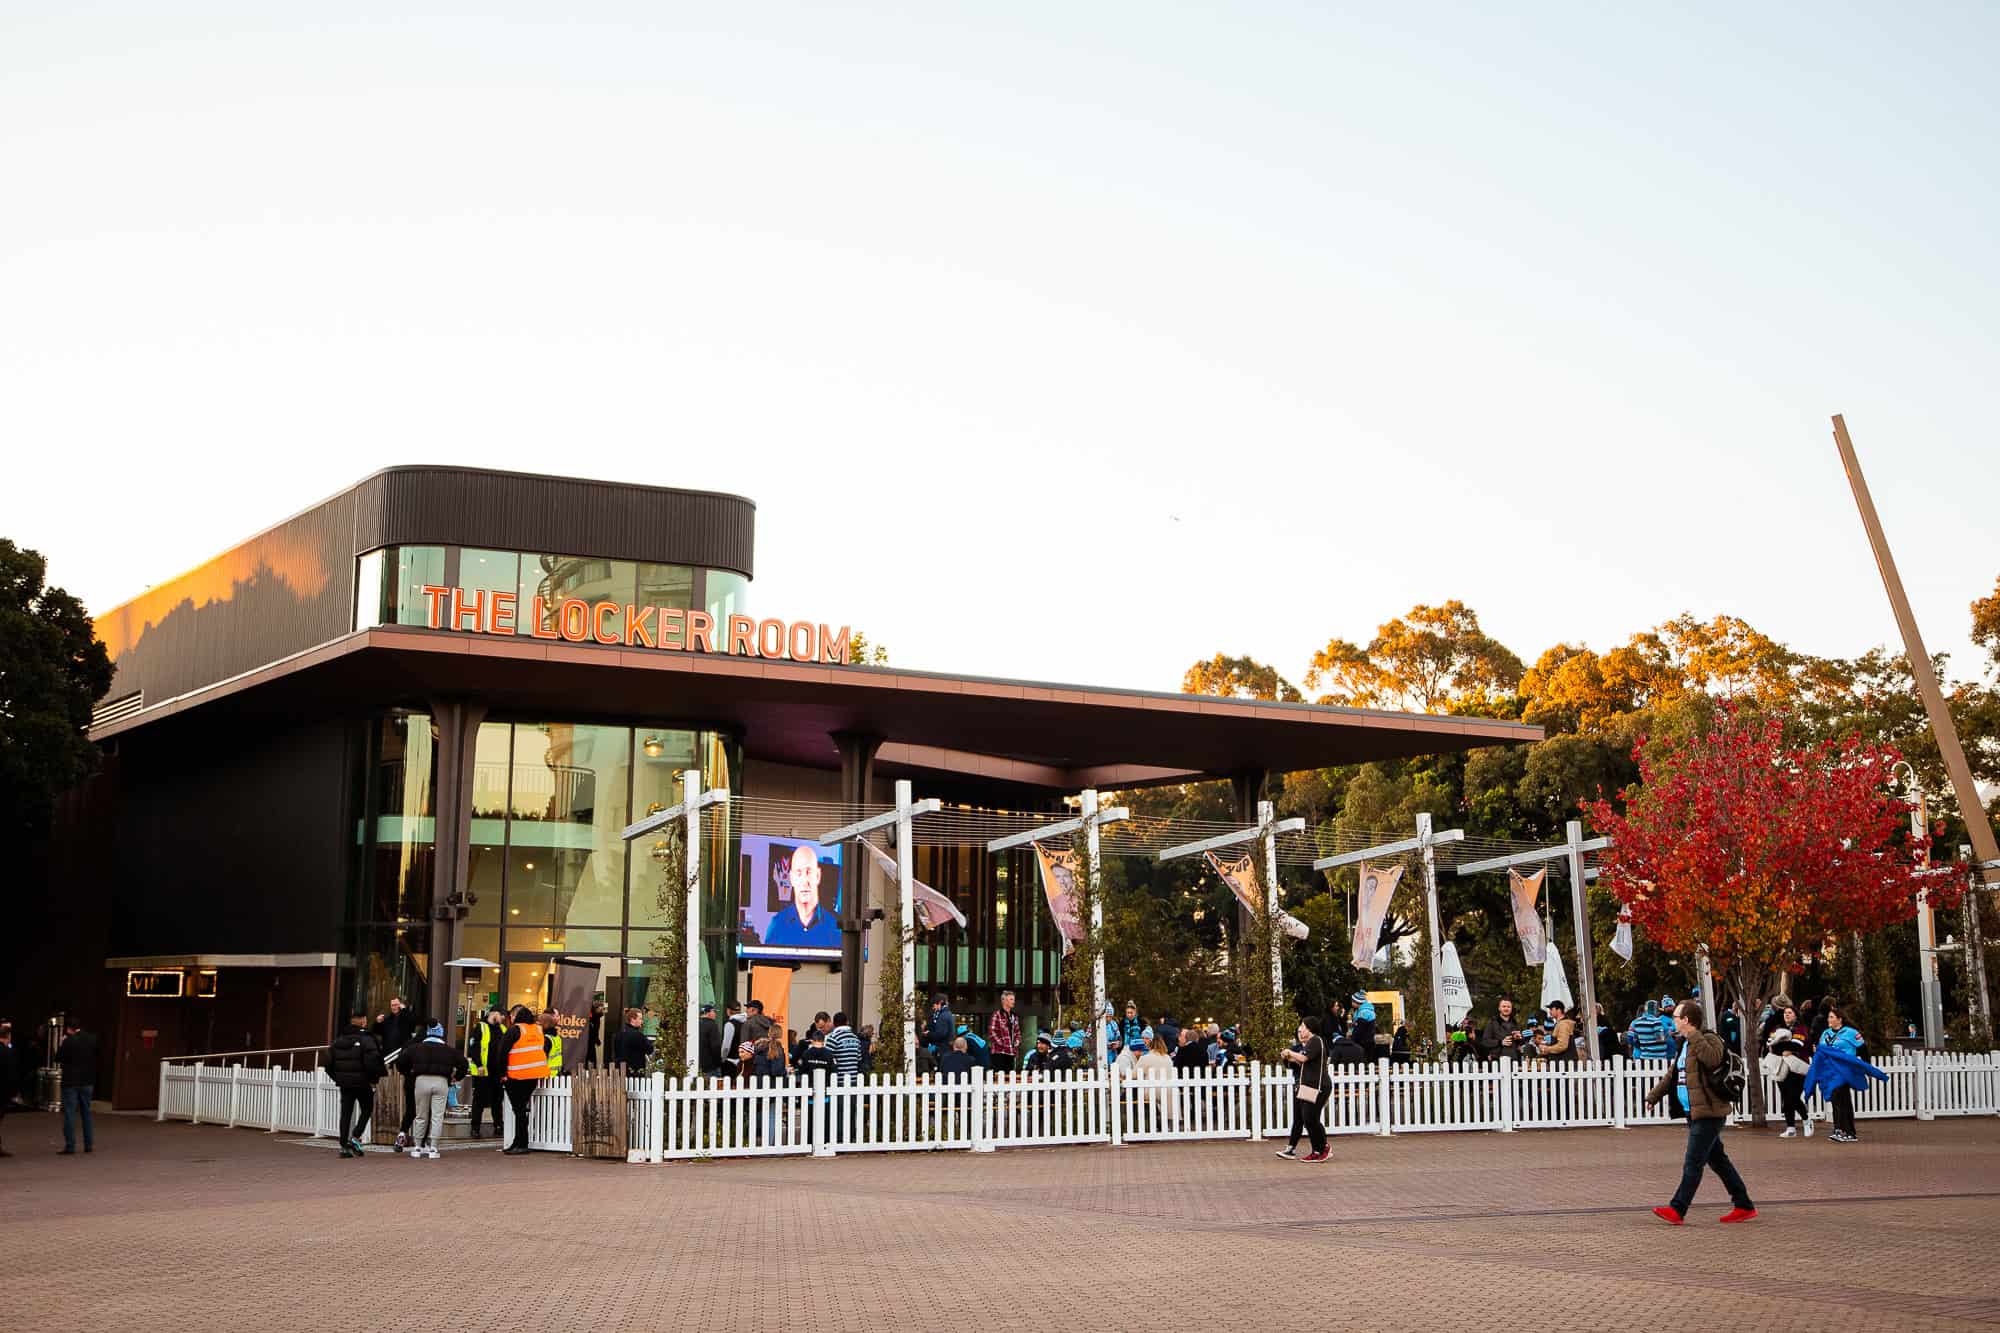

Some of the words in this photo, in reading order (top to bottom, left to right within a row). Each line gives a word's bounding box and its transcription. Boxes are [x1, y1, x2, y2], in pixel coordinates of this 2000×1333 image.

[422, 584, 516, 635] THE
[530, 596, 714, 654] LOCKER
[729, 614, 851, 665] ROOM
[557, 1014, 587, 1027] loke
